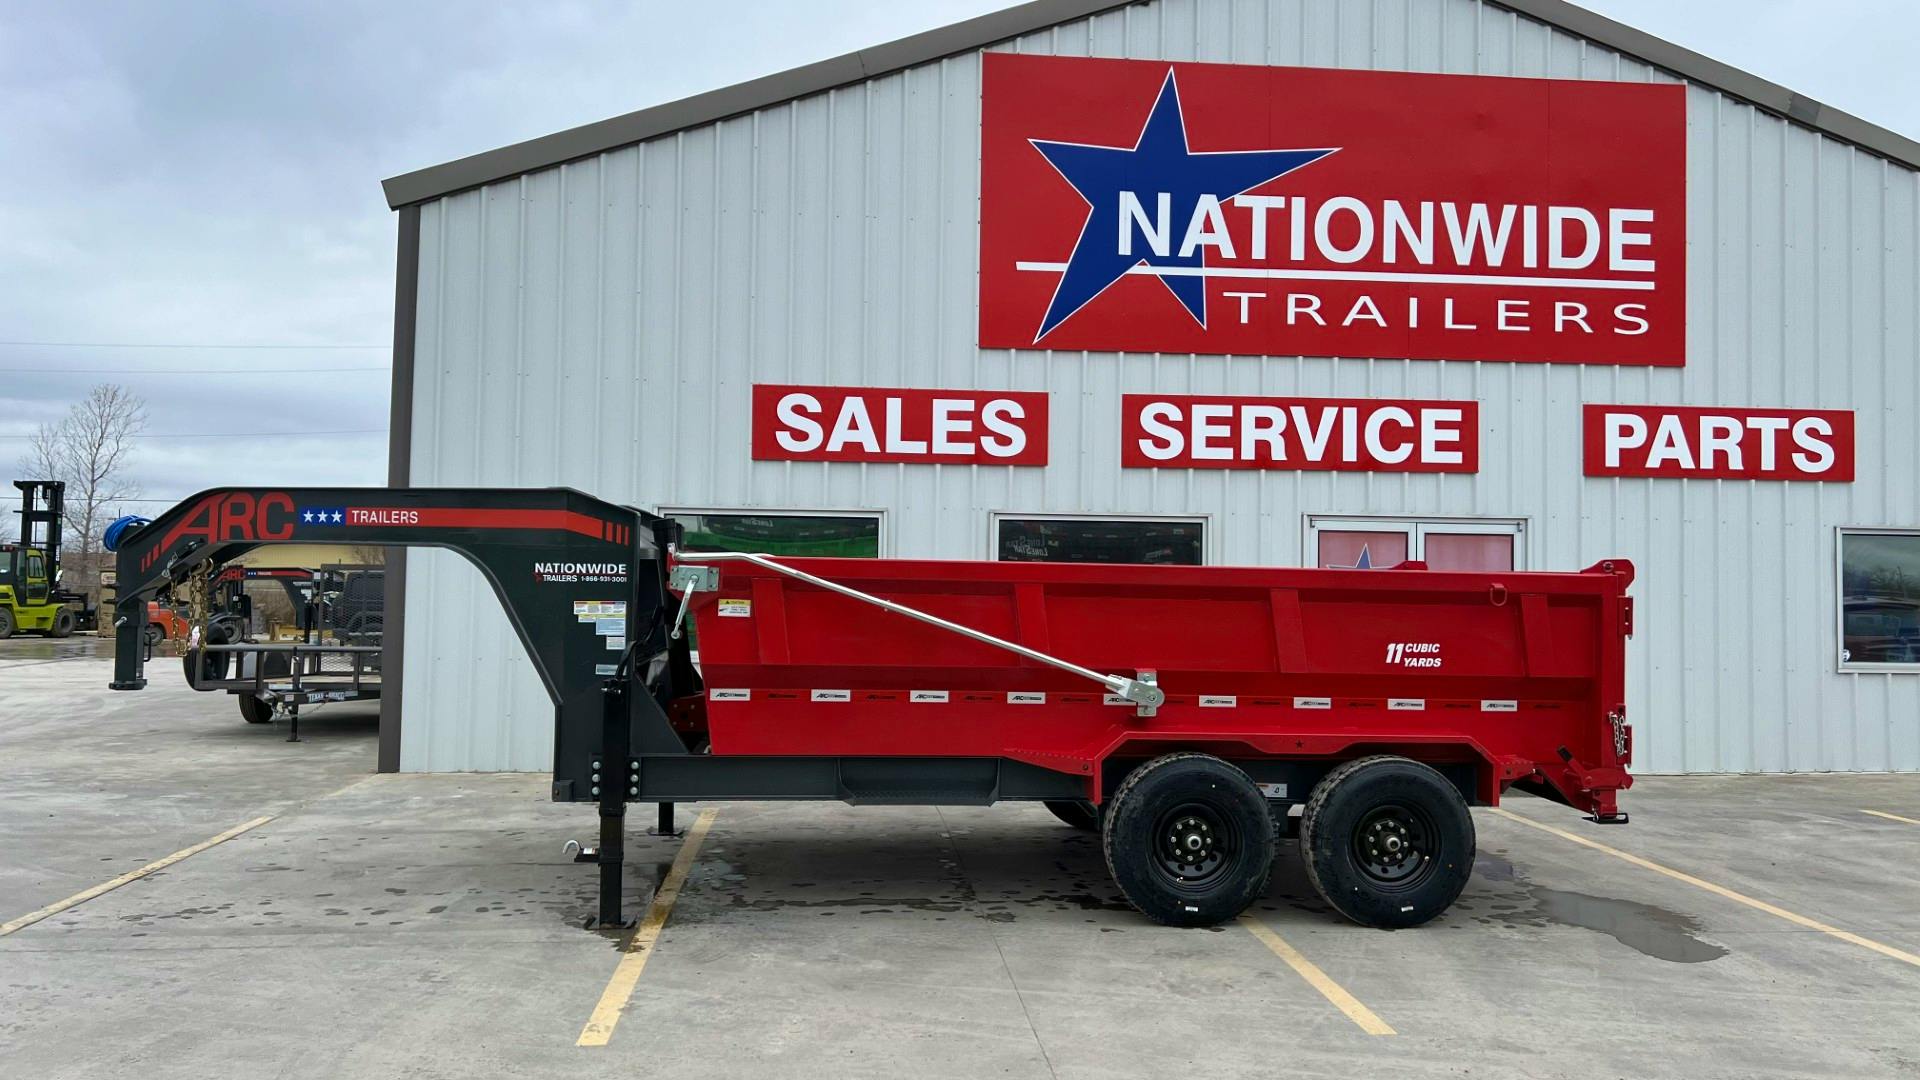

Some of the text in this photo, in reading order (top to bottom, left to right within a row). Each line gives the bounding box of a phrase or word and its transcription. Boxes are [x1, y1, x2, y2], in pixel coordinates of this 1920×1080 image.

[1117, 190, 1656, 273] NATIONWIDE
[1222, 291, 1651, 336] TRAILERS
[775, 393, 1027, 457] SALES
[1138, 402, 1464, 465] SERVICE
[1604, 413, 1836, 473] PARTS
[160, 492, 294, 553] ARC
[351, 509, 418, 524] TRAILERS
[534, 562, 627, 575] NATIONWIDE
[543, 574, 578, 582] TRAILERS
[1386, 643, 1441, 664] 11 CUBIC
[1404, 657, 1442, 668] YARDS
